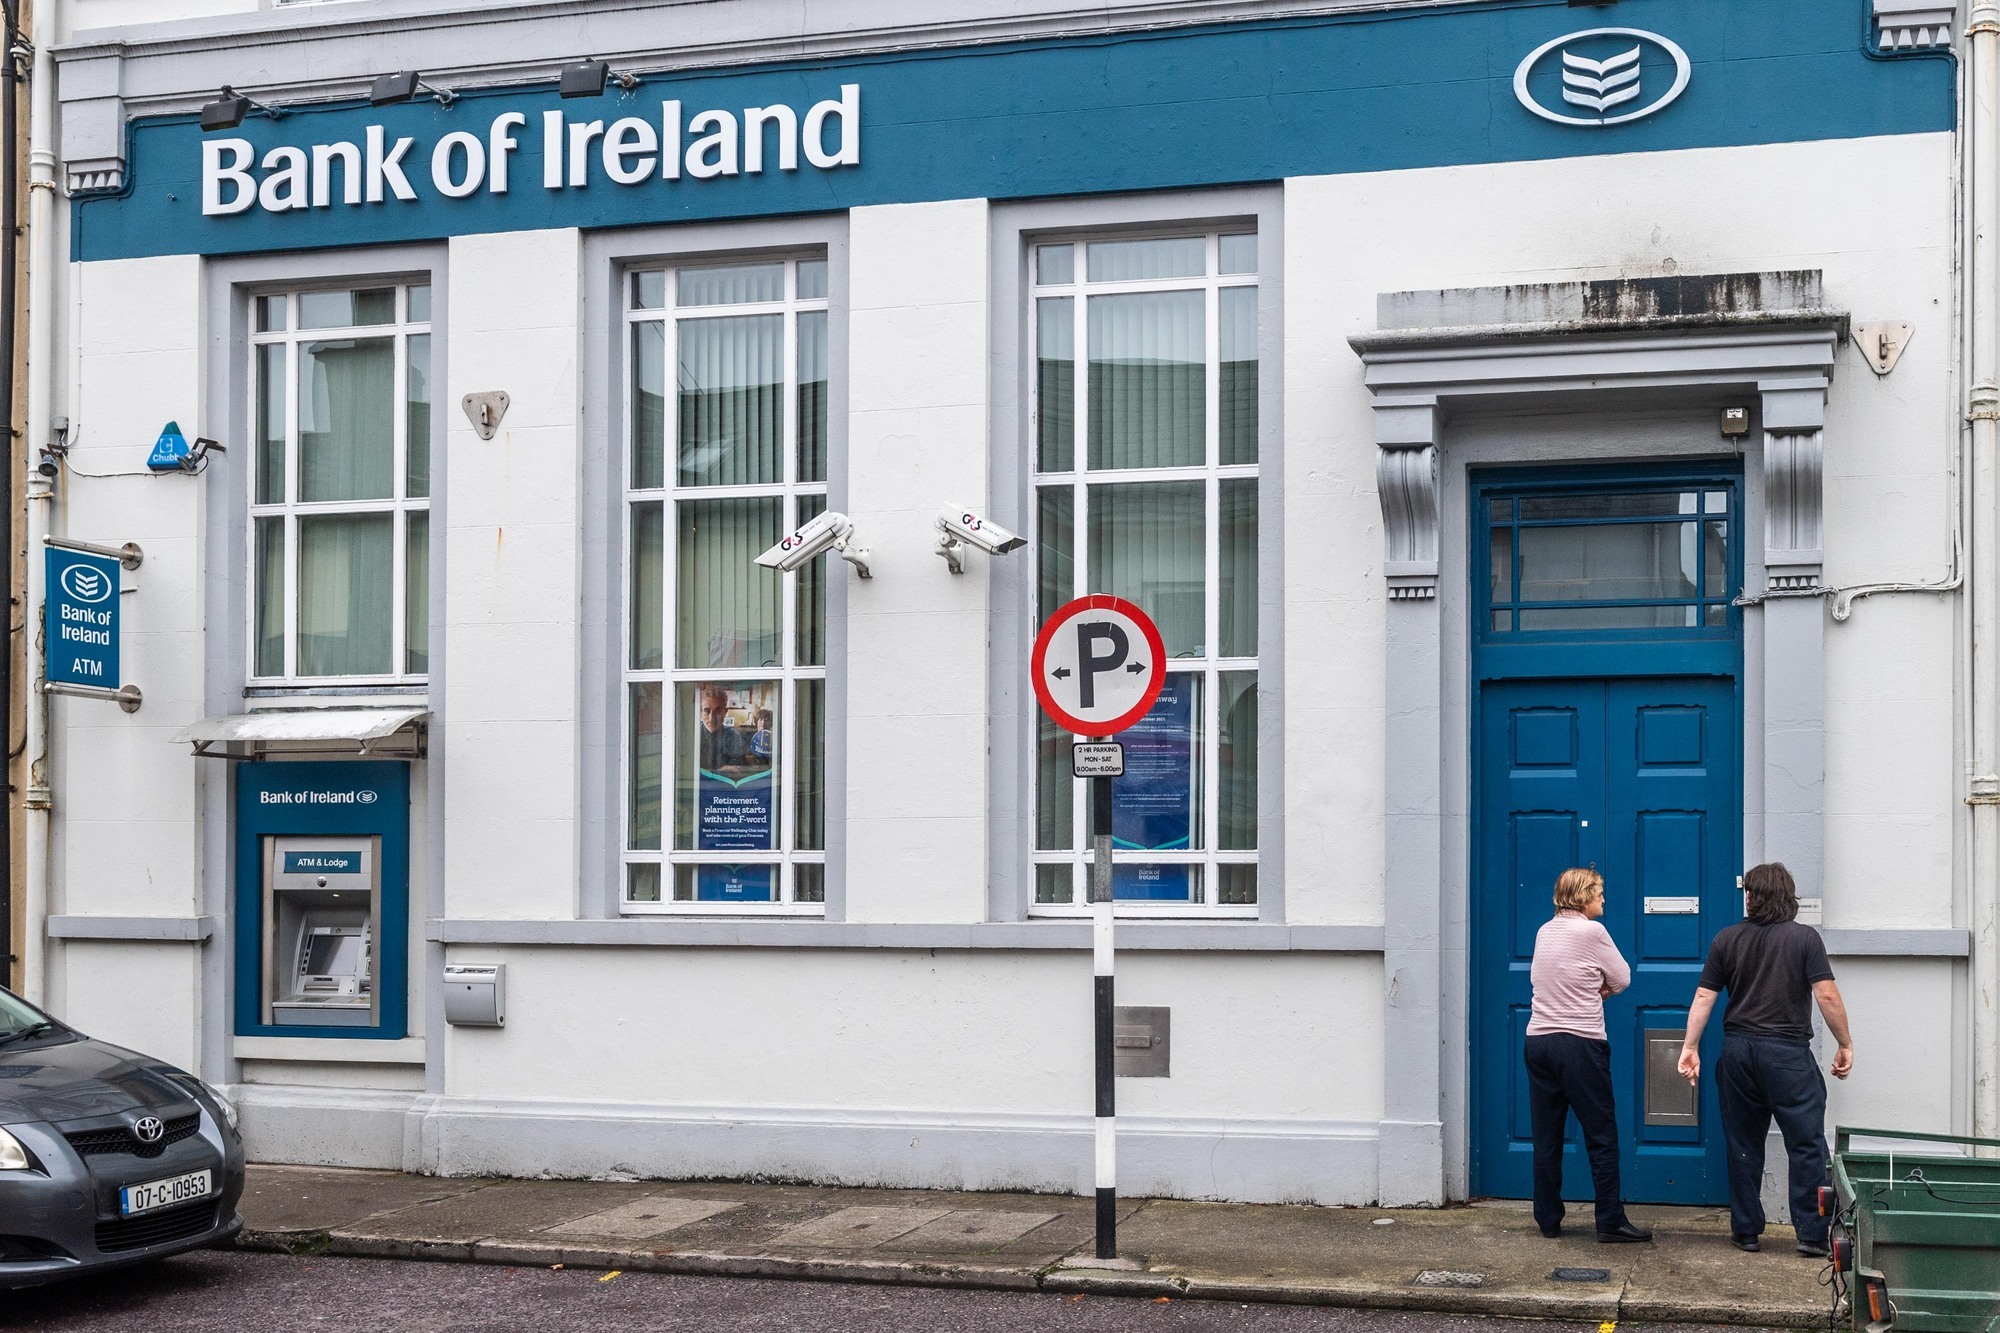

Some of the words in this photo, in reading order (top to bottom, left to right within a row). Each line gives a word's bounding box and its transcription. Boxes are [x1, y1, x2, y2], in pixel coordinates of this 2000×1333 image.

[202, 124, 418, 216] Bank
[431, 111, 526, 198] of
[543, 83, 861, 189] Ireland
[61, 603, 96, 624] Bank
[97, 611, 112, 626] of
[61, 623, 110, 645] Ireland
[72, 657, 102, 676] ATM
[1077, 621, 1130, 709] P
[260, 791, 293, 804] Bank
[294, 791, 309, 804] of
[310, 791, 355, 804] Ireland
[713, 796, 759, 805] Retirement
[703, 815, 723, 823] with
[723, 815, 738, 823] the
[738, 815, 767, 823] F-word
[704, 805, 741, 815] planning
[741, 806, 766, 814] starts
[297, 858, 315, 866] ATM
[316, 858, 322, 866] &
[324, 858, 348, 868] Lodge
[135, 1175, 206, 1209] 07-C-10953
